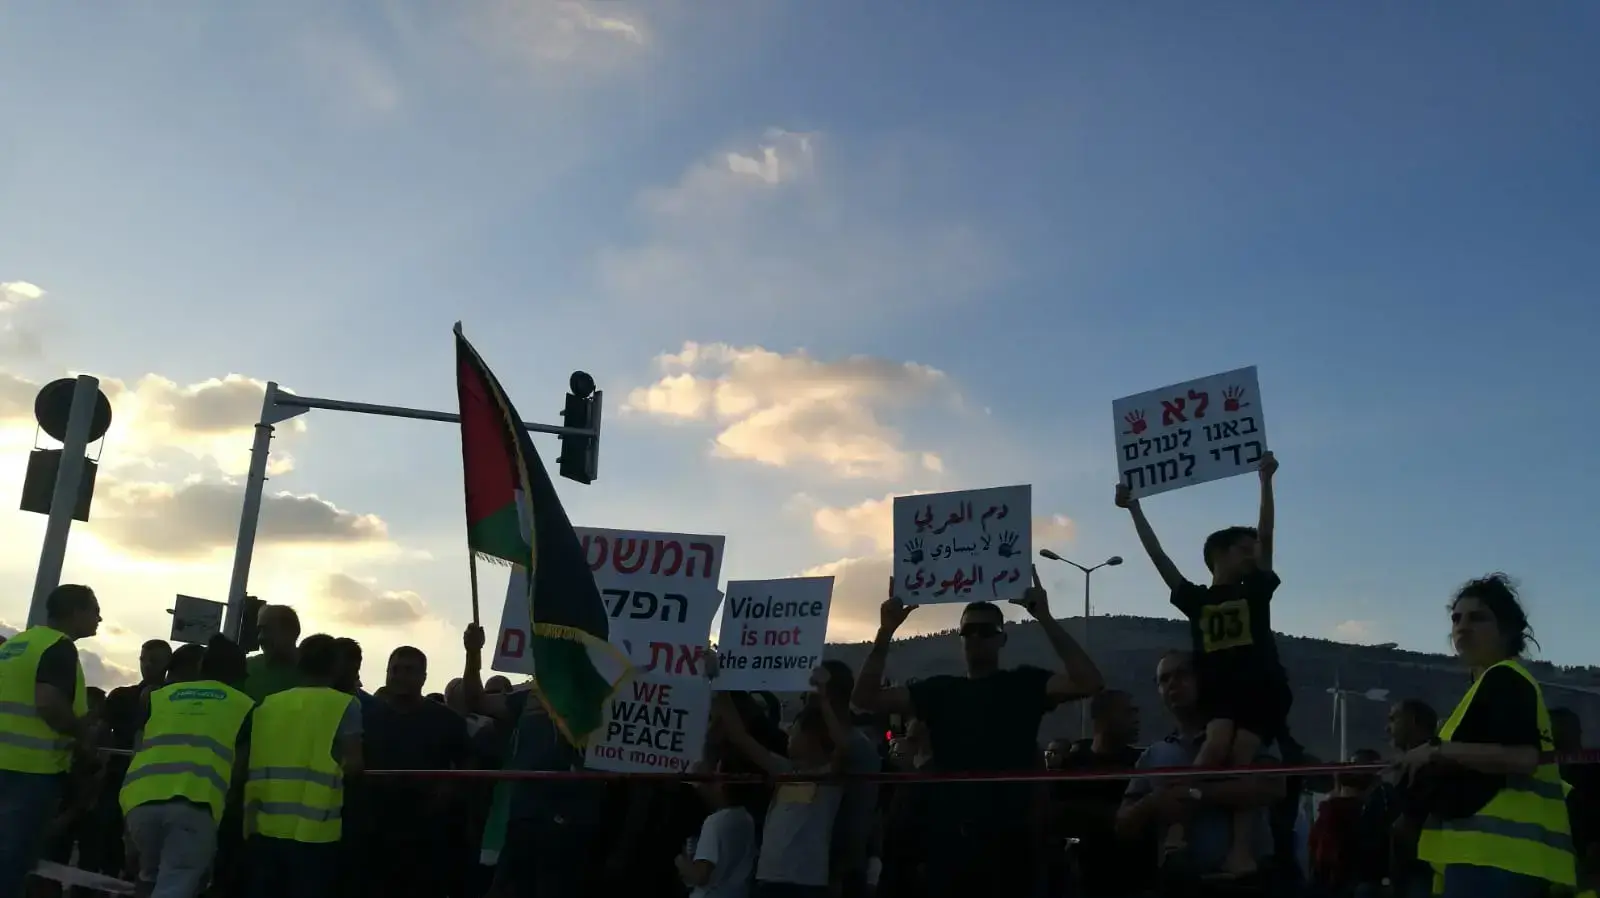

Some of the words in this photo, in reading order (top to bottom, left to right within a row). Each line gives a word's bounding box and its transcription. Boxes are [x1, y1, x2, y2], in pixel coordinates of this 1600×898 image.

[1160, 388, 1209, 426] לא
[1203, 416, 1258, 442] באנו
[1123, 428, 1192, 461] לעולם
[1209, 440, 1262, 466] כדי
[1123, 452, 1196, 491] למות
[914, 500, 972, 535] العربي
[981, 504, 1009, 533] دم
[582, 535, 714, 579] המשט
[930, 537, 976, 561] يساوي
[980, 534, 991, 551] لا
[905, 563, 983, 598] اليهودي
[991, 568, 1020, 596] دم
[602, 589, 688, 623] הפק
[729, 596, 823, 620] Violence
[741, 626, 758, 646] is
[764, 626, 801, 646] not
[1209, 608, 1243, 642] 03
[719, 650, 747, 670] the
[751, 653, 817, 670] answer
[633, 681, 672, 706] WE
[611, 701, 689, 730] WANT
[606, 721, 685, 752] PEACE
[594, 744, 624, 760] not
[629, 750, 690, 774] money
